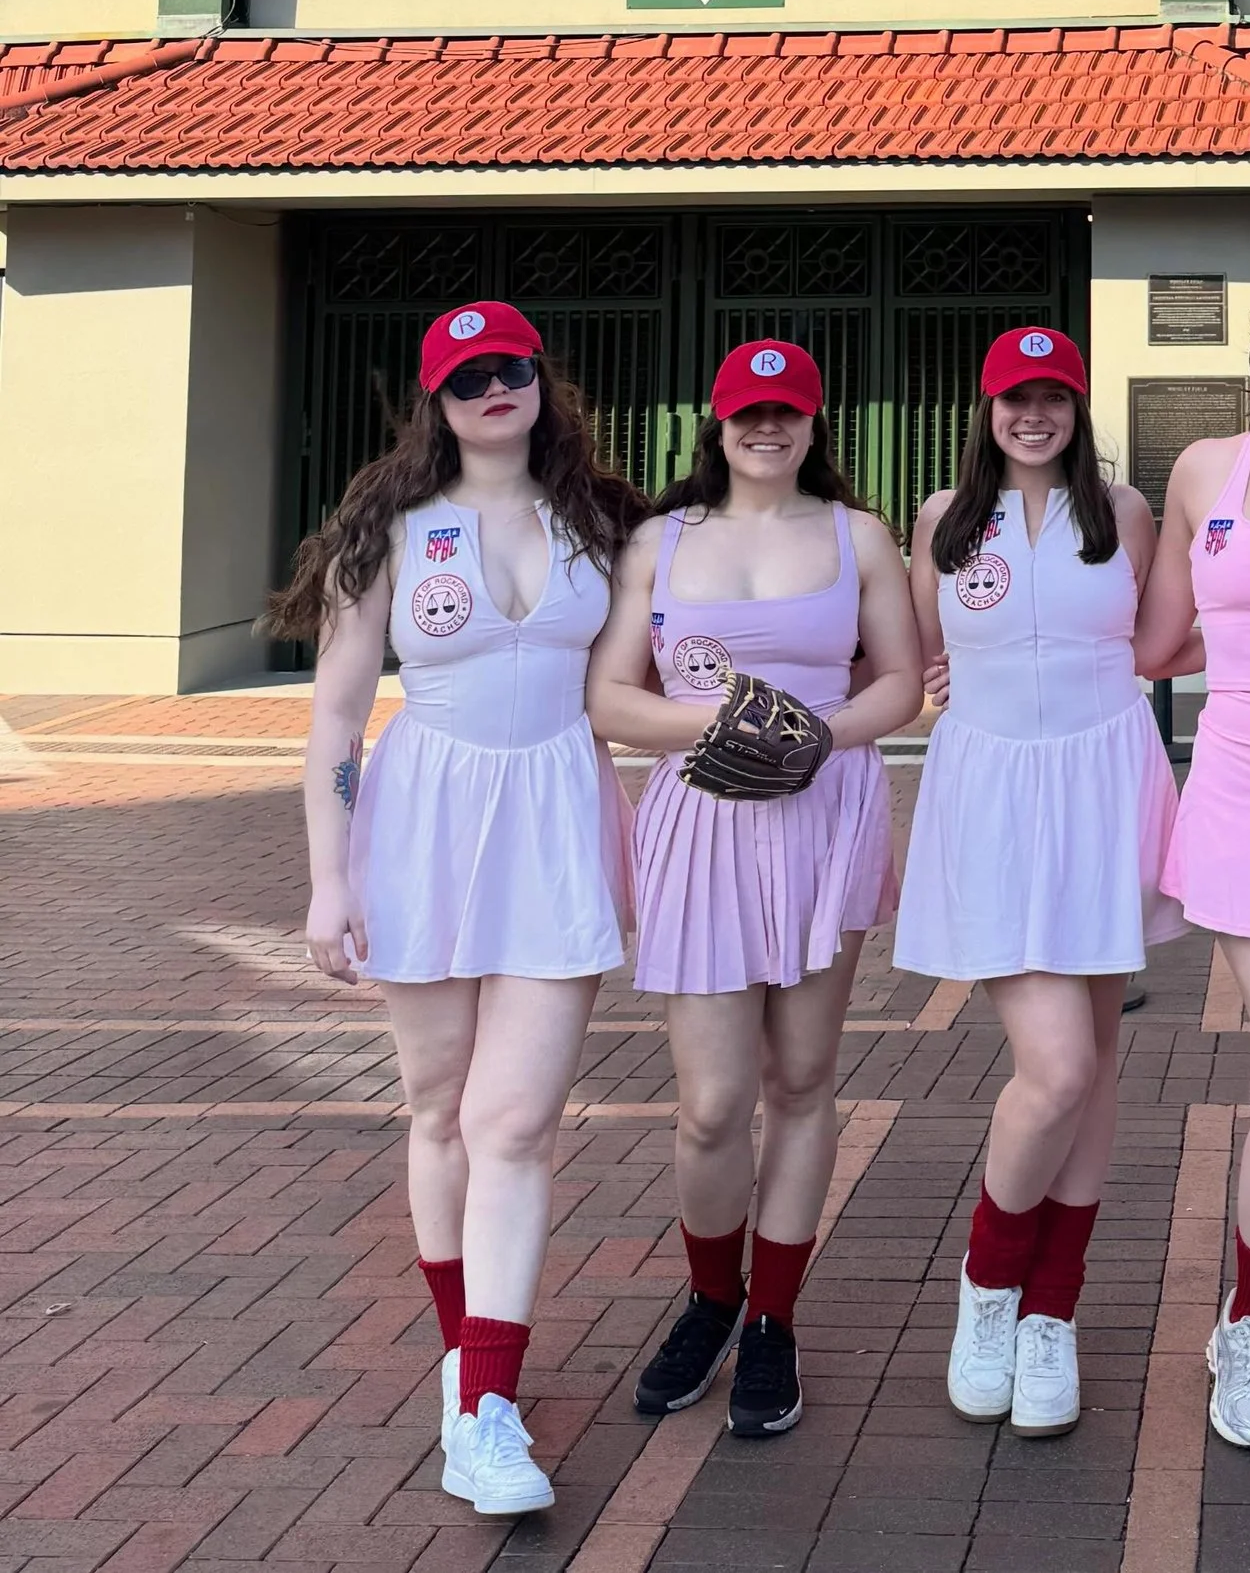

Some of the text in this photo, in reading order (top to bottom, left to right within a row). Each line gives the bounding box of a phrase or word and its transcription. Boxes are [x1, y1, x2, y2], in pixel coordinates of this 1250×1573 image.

[458, 315, 475, 335] R
[1030, 335, 1045, 352] R
[760, 352, 776, 371] R
[415, 577, 469, 613] CITY OF ROCKFORD
[962, 591, 1001, 607] PEACHES
[422, 614, 465, 633] PEACHES
